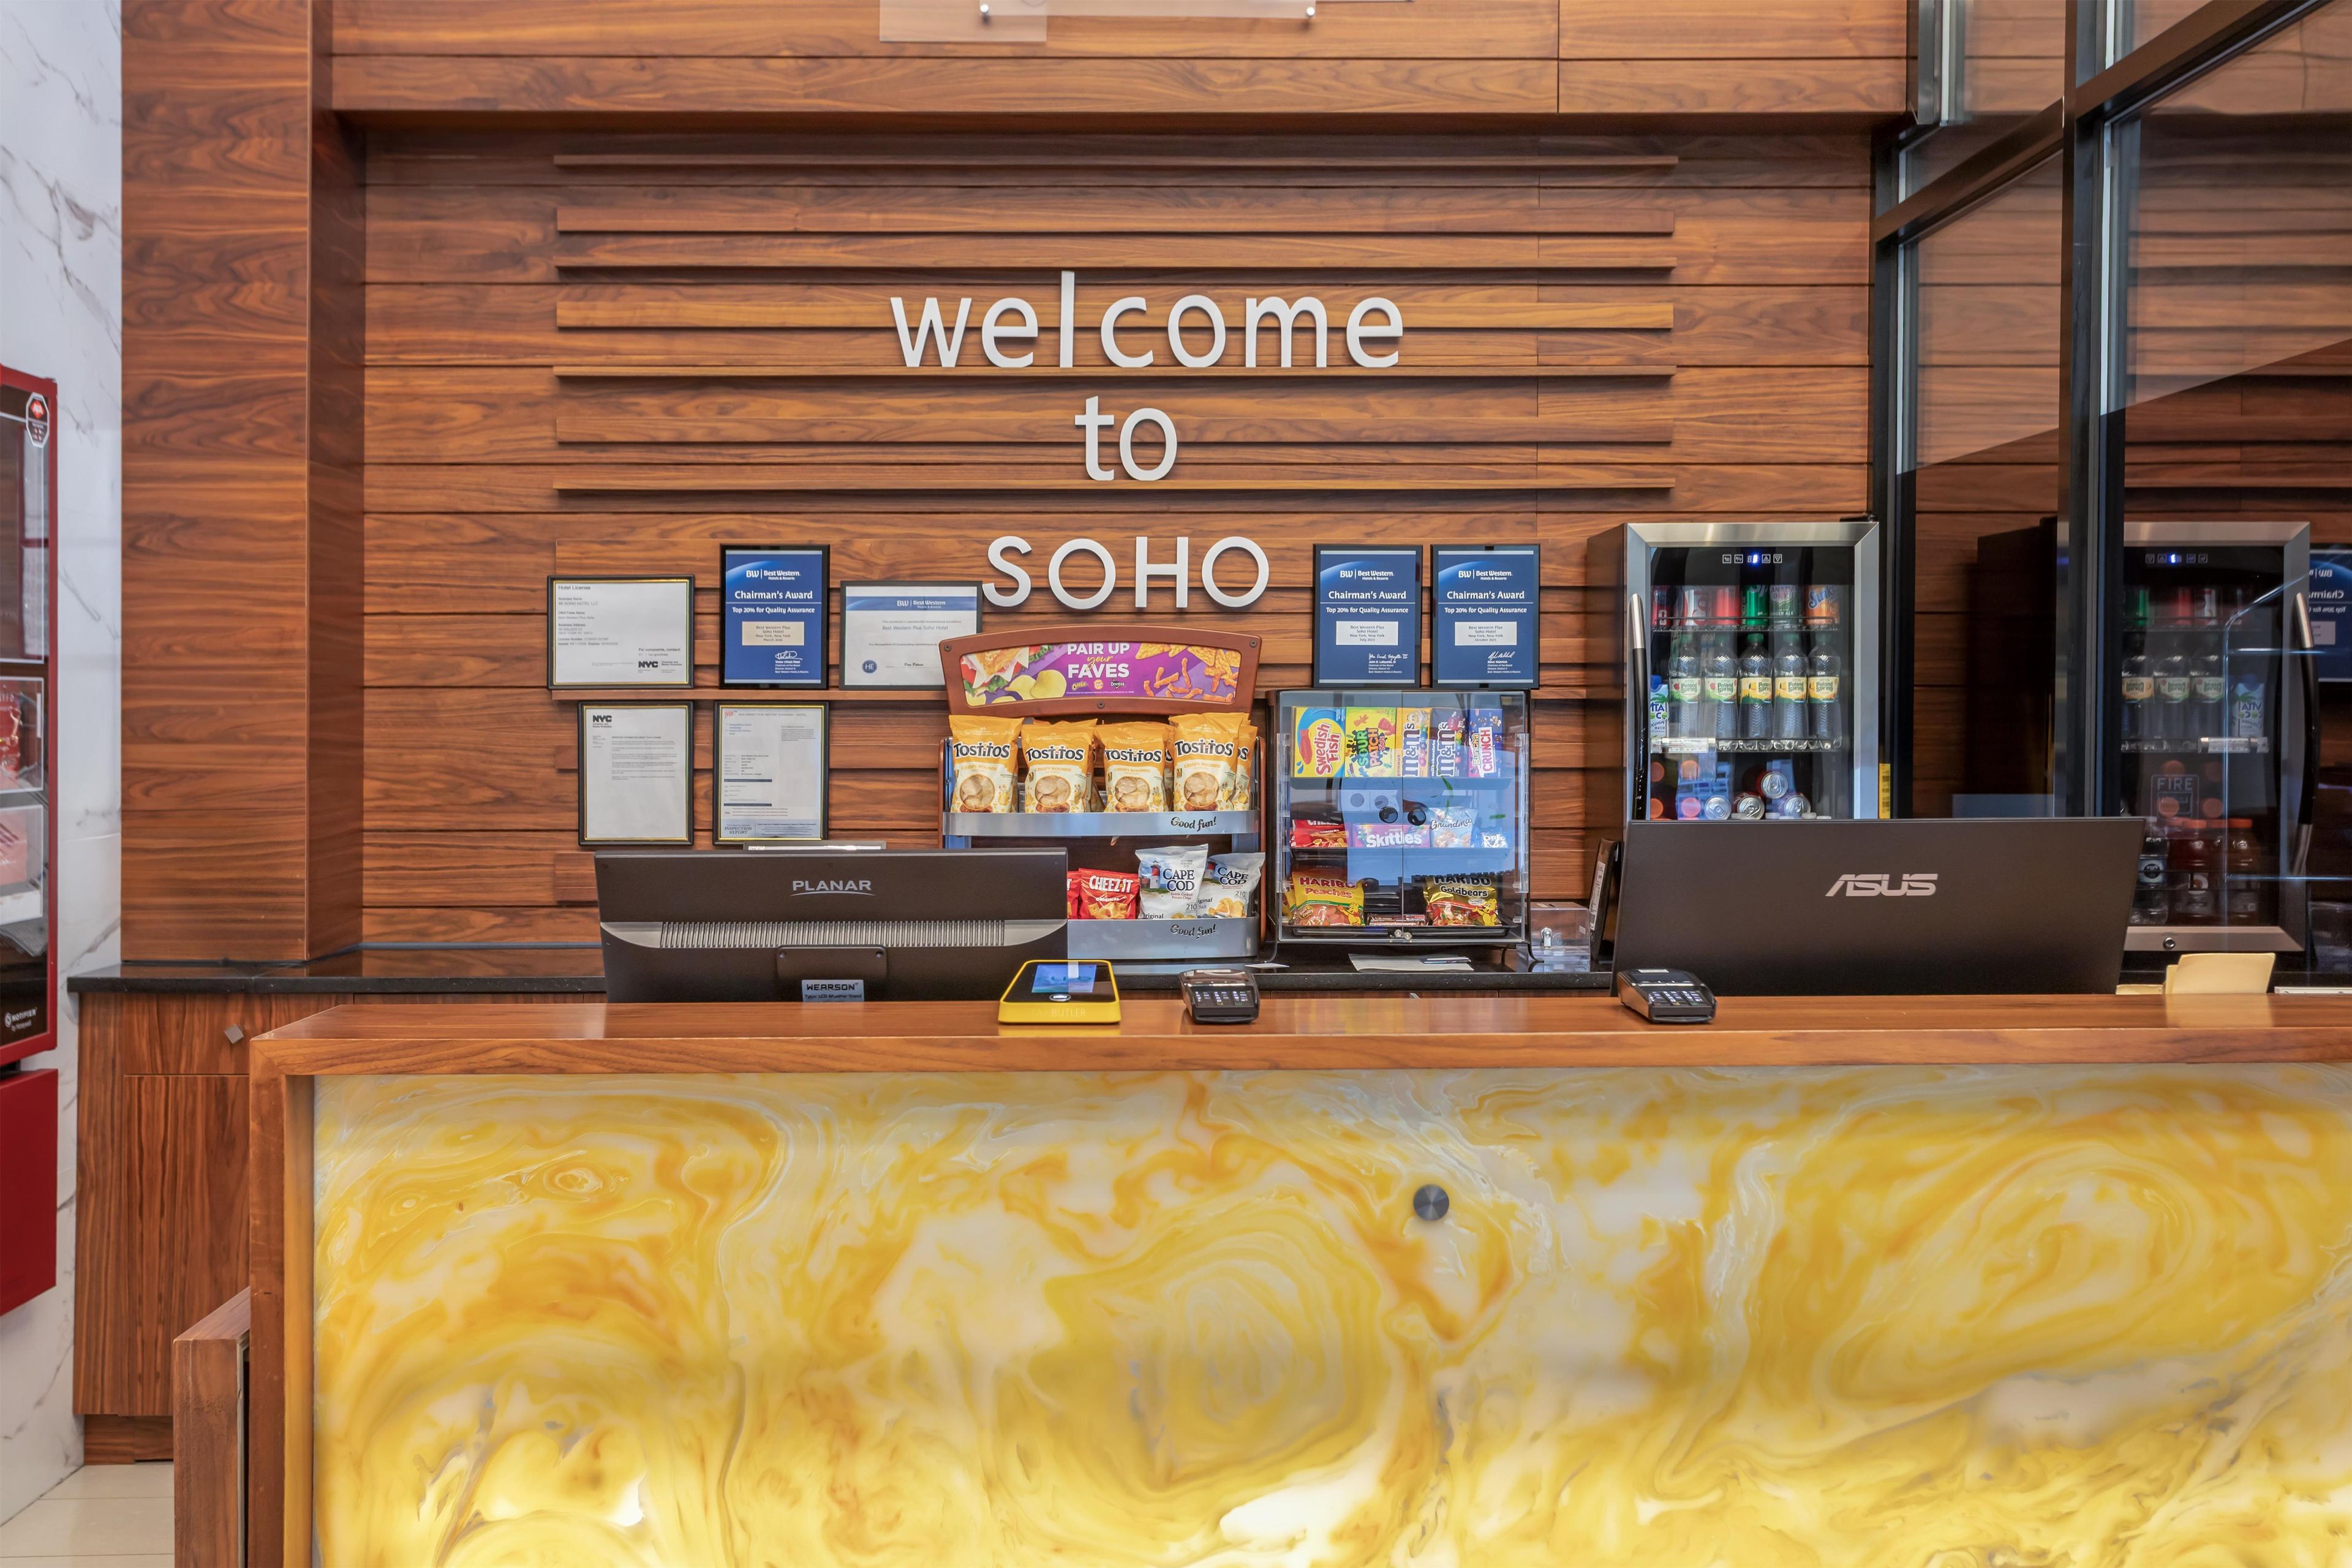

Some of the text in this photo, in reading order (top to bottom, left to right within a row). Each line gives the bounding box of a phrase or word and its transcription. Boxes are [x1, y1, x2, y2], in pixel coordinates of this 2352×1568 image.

[890, 271, 1404, 368] welcome
[1075, 395, 1178, 481] to
[982, 536, 1269, 609] SOHO
[734, 590, 813, 599] Chairman's Award
[1067, 643, 1130, 655] PAIR UP
[1068, 663, 1129, 678] FAVES
[1087, 656, 1114, 672] your
[953, 742, 1010, 758] Tostitos
[1026, 745, 1084, 761] Tostitos
[1174, 739, 1234, 756] Tostitos
[1314, 722, 1332, 775] Swedish
[1326, 733, 1341, 763] Fish
[1357, 730, 1369, 766] SOUR
[1367, 728, 1382, 767] PATCH
[1480, 729, 1493, 772] CRUNCH
[1105, 748, 1162, 763] Tostitos
[2157, 777, 2193, 791] FIRE
[1170, 816, 1216, 832] Good fun!
[1366, 831, 1422, 848] Skittles
[1163, 868, 1195, 880] CAPE
[1217, 867, 1249, 880] CAPE
[1219, 876, 1247, 885] COD
[793, 880, 872, 891] PLANAR
[1166, 880, 1195, 891] COD
[1299, 877, 1357, 888] HARIBO
[1825, 873, 1939, 897] ASUS
[1305, 888, 1352, 899] Peaches
[1440, 886, 1488, 897] Goldbears
[1170, 924, 1194, 937] Good
[1033, 1008, 1086, 1017] BUTLER
